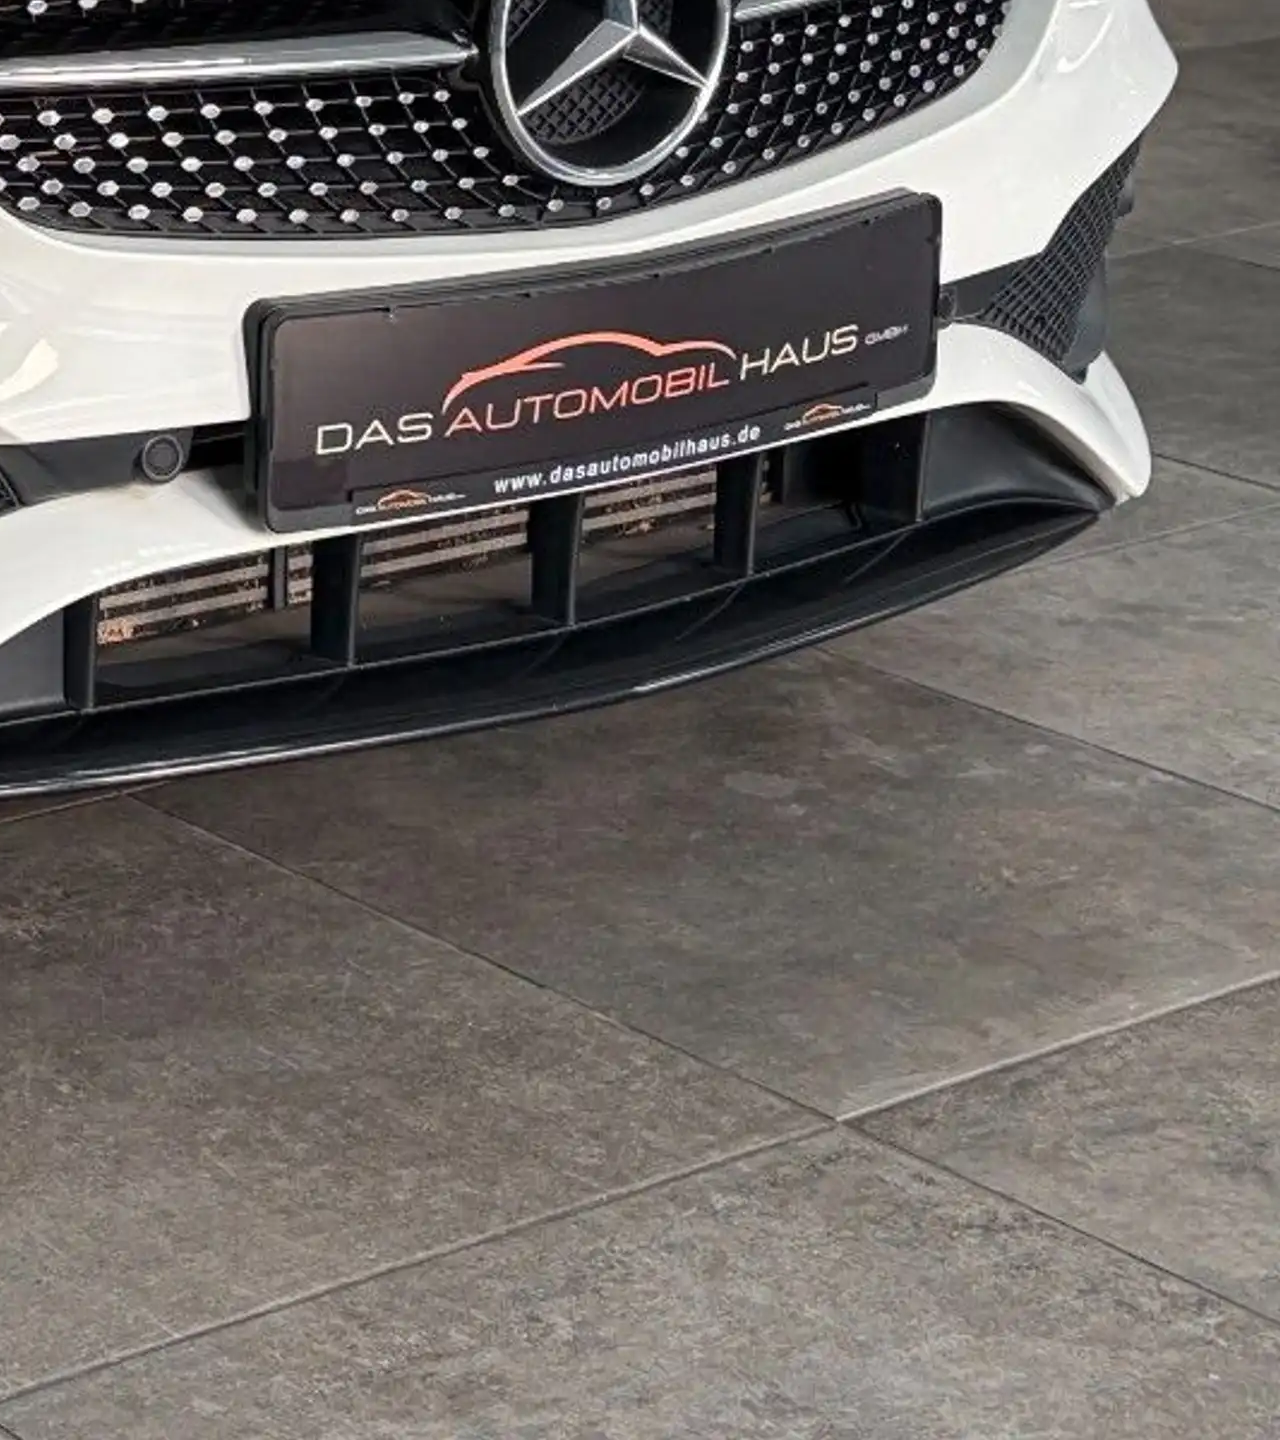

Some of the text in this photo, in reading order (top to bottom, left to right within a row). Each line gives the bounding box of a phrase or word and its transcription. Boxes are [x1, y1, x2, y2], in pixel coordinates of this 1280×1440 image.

[315, 412, 435, 456] DAS
[443, 362, 731, 438] AUTOMOBIL
[739, 323, 859, 381] HAUS
[493, 424, 762, 494] www.dasautomobilhaus.de
